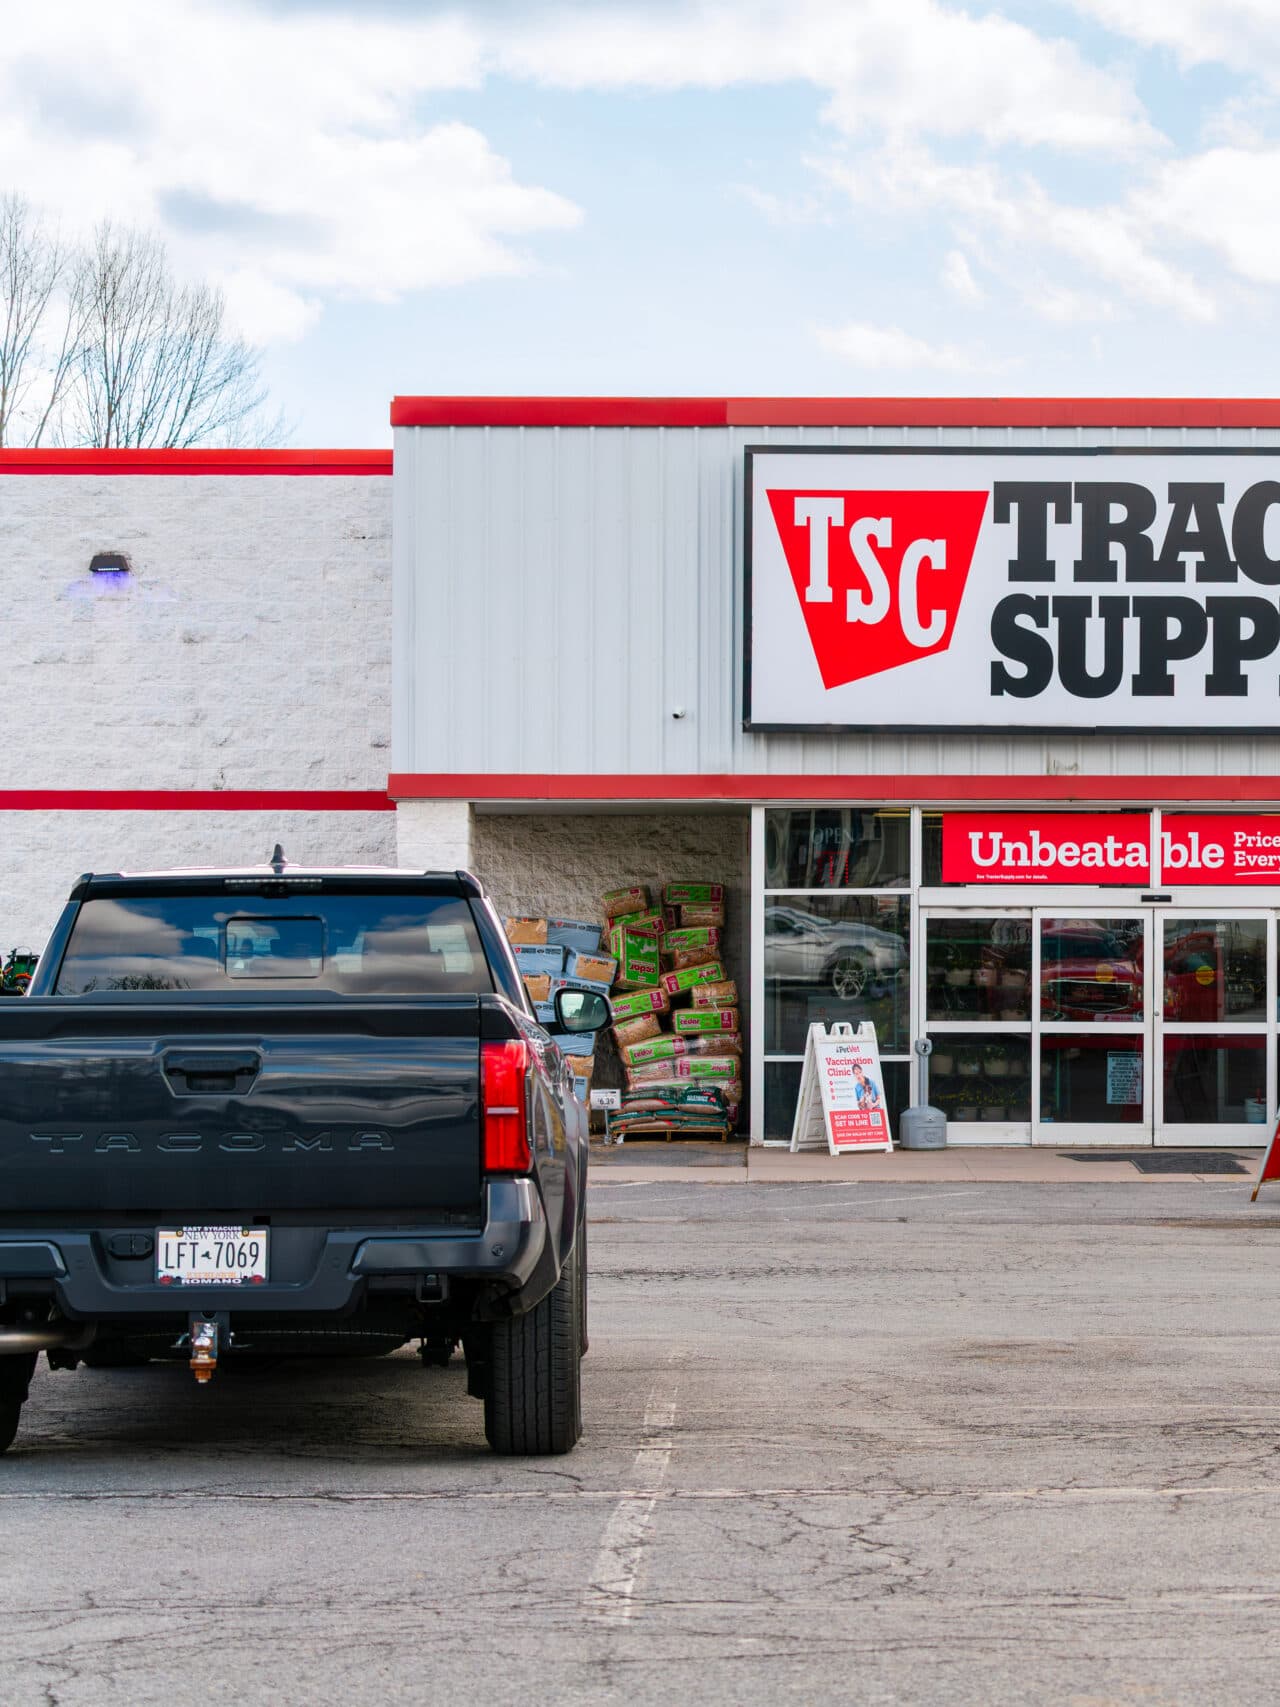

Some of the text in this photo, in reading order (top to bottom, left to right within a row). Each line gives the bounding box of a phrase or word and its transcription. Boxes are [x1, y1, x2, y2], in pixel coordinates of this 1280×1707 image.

[794, 497, 946, 648] TSC
[968, 830, 1225, 869] Unbeatable
[825, 1056, 873, 1065] Vaccination
[827, 1067, 851, 1076] Clinic
[29, 1131, 395, 1153] TACOMA
[184, 1231, 240, 1240] NEW YORK
[165, 1241, 260, 1269] LFT 7069
